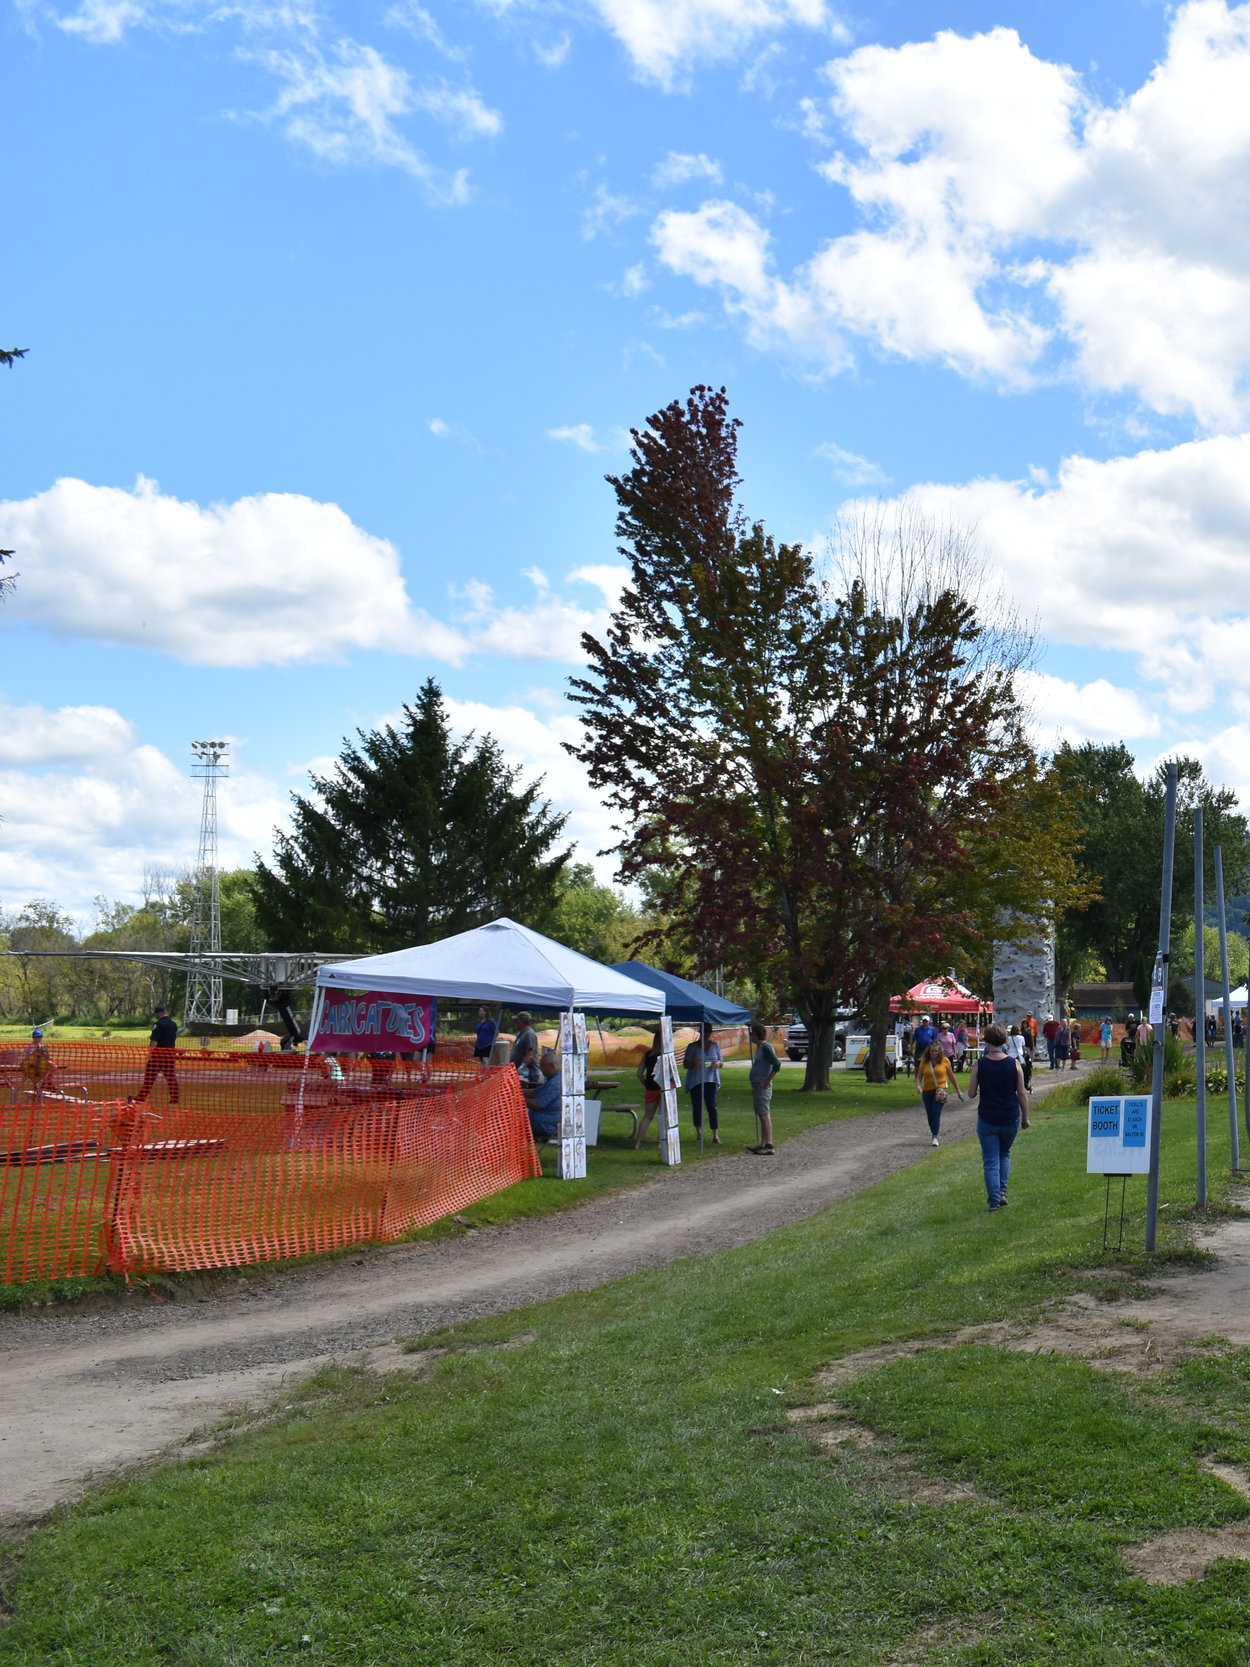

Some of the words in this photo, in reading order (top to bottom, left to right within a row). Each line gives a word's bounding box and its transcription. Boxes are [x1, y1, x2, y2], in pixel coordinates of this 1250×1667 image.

[320, 1000, 425, 1043] CARICATURES
[1094, 1105, 1119, 1115] TICKET
[1092, 1121, 1118, 1130] BOOTH
